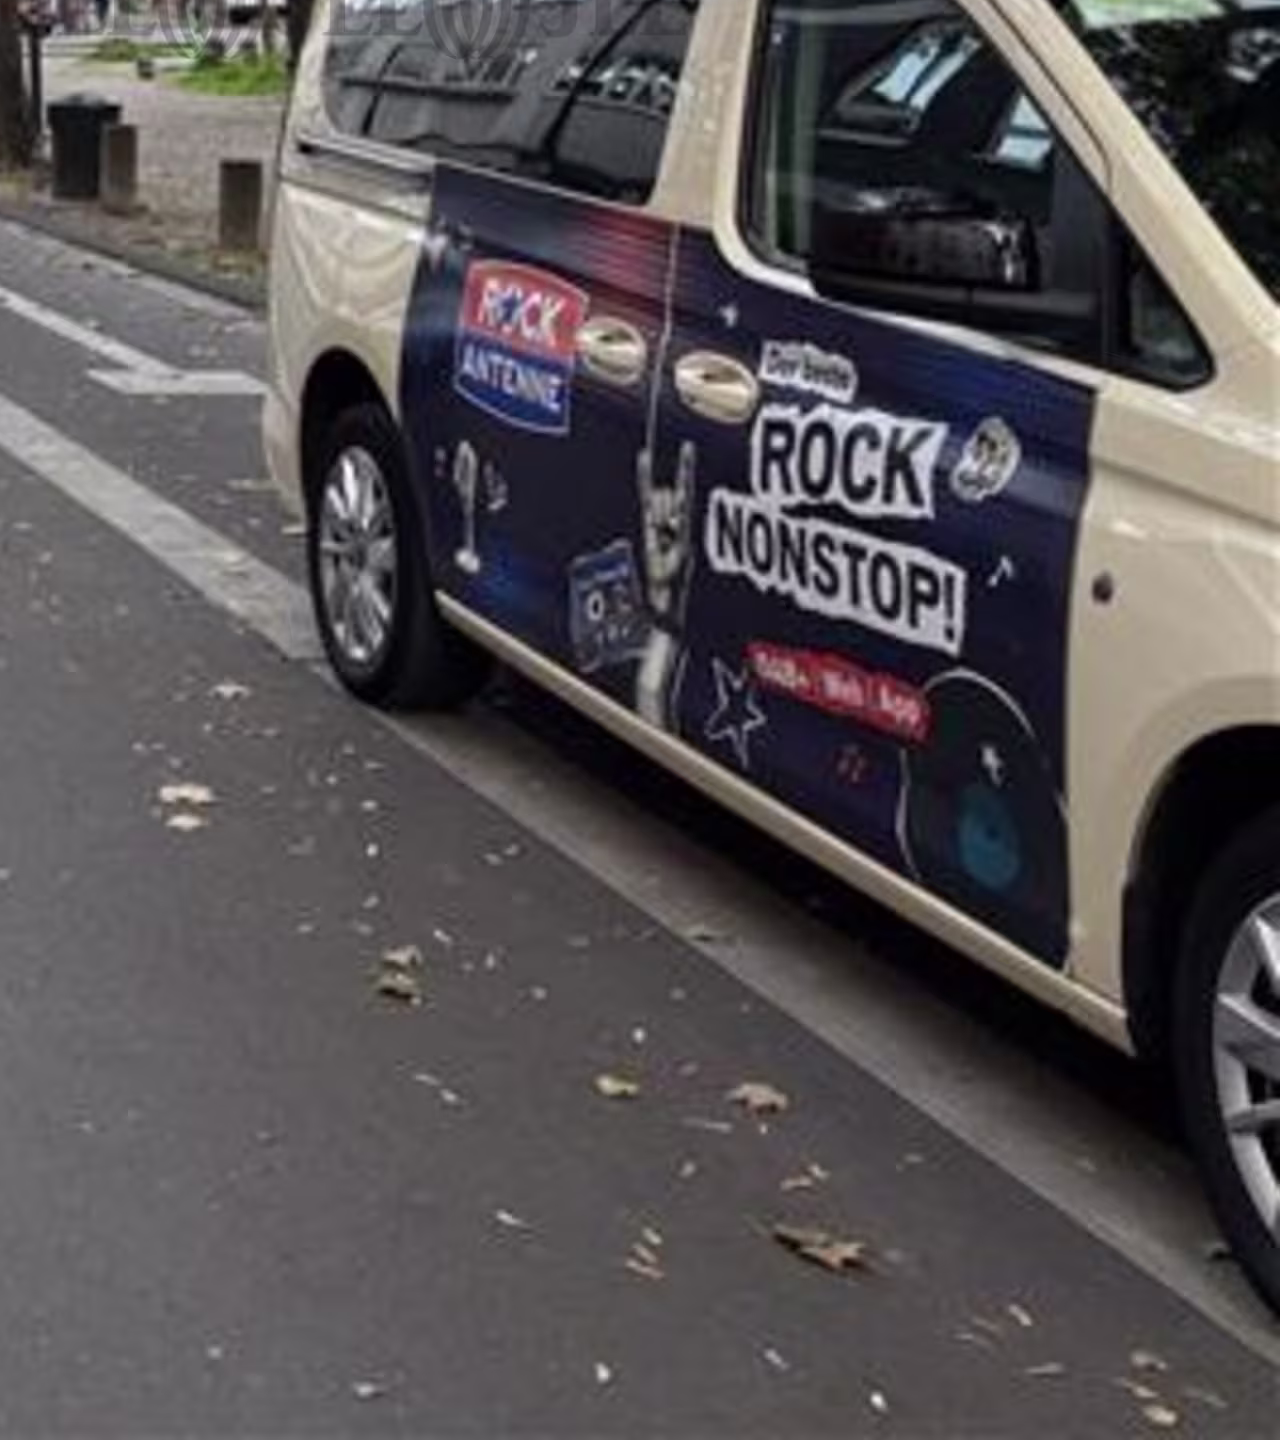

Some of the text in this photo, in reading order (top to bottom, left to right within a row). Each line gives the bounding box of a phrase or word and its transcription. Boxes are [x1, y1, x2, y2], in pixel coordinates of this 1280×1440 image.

[460, 345, 564, 412] ANTENNE
[759, 417, 936, 508] ROCK
[714, 505, 959, 643] NONSTOP!
